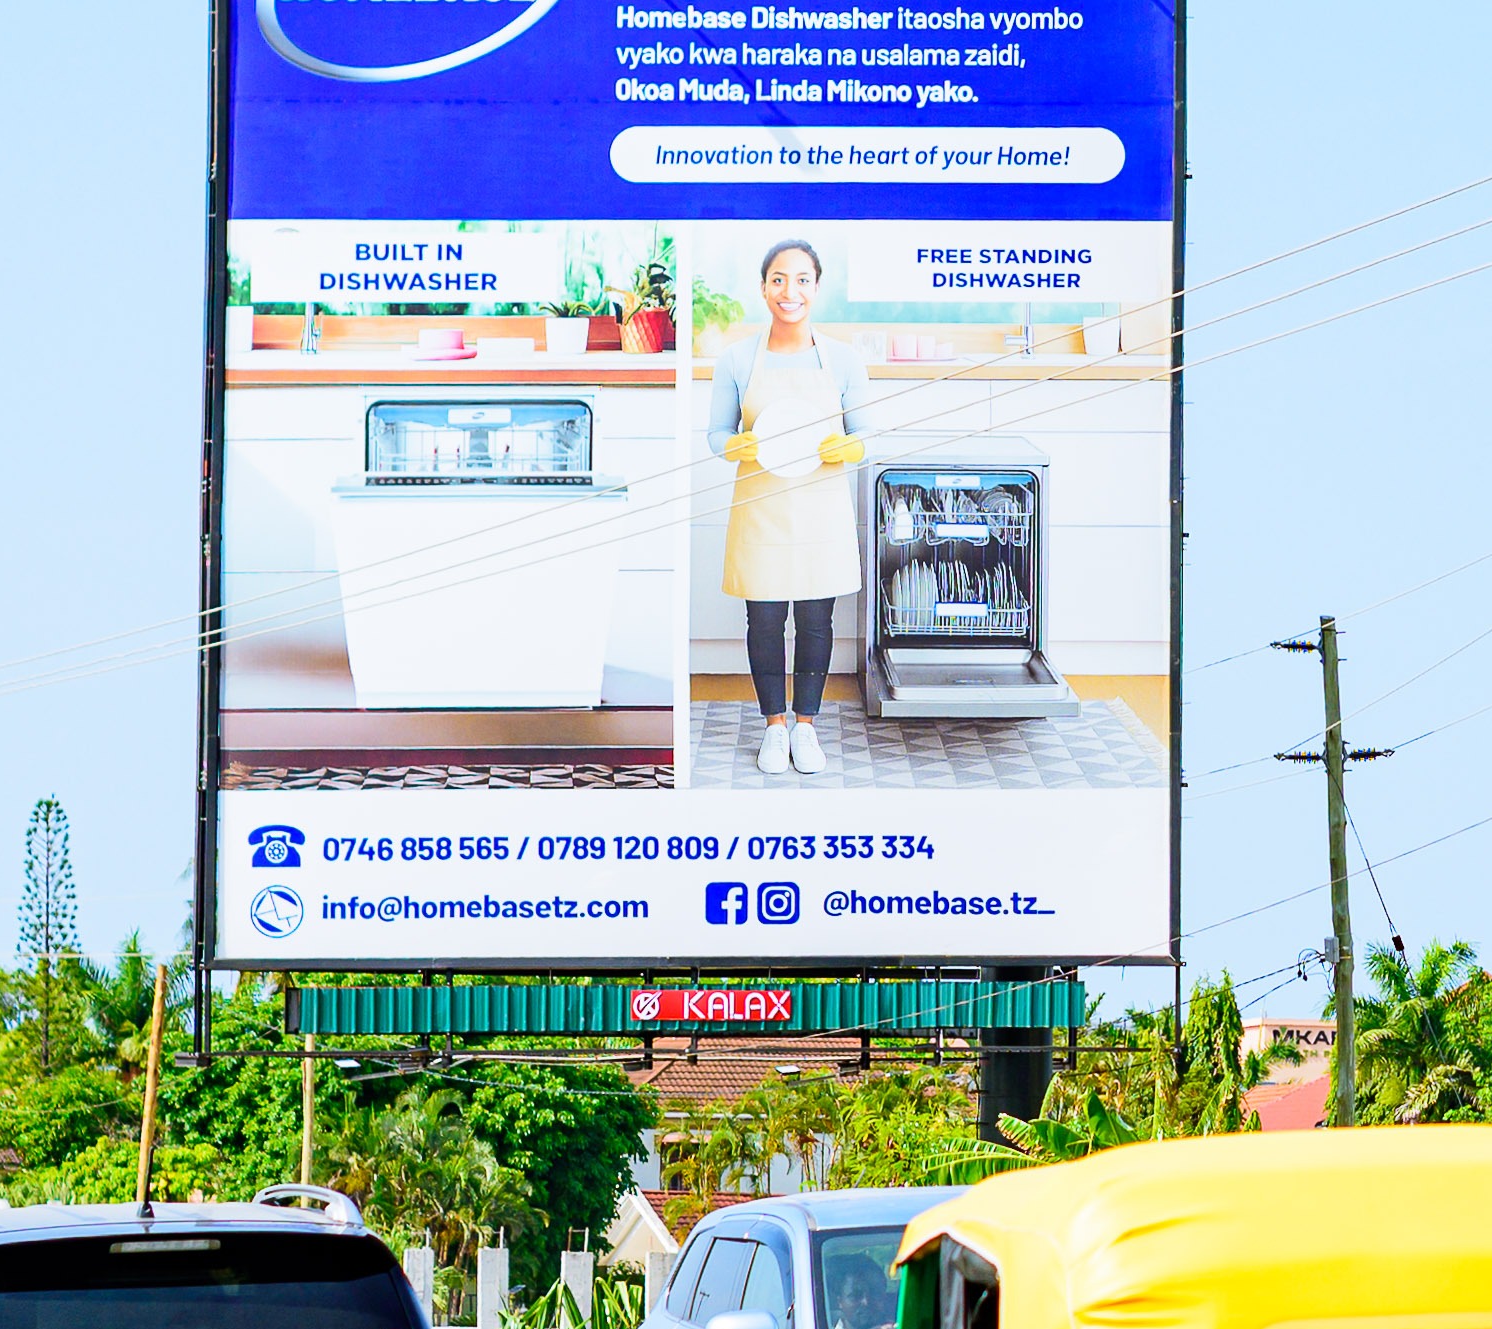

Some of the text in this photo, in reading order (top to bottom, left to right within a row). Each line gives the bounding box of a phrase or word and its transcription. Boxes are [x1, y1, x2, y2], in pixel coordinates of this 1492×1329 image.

[616, 4, 1084, 35] Homebase Dishwasher itaosha vyombo
[616, 41, 1026, 70] vyako kwa haraka na usalama zaidi,
[615, 77, 979, 109] Okoa Muda, Linda Mikono yako.
[655, 145, 1071, 171] Innovation to the heart of your Home!
[355, 243, 463, 261] BUILT IN
[917, 248, 1092, 264] FREE STANDING
[319, 272, 497, 291] DISHWASHER
[932, 272, 1081, 288] DISHWASHER
[323, 835, 935, 862] 0746 858 565 / 0789 120 809 / 0763 353 334
[322, 894, 649, 923] info@homebasetz.com
[823, 889, 1056, 917] @homebase.tz_
[683, 991, 791, 1020] KALAX
